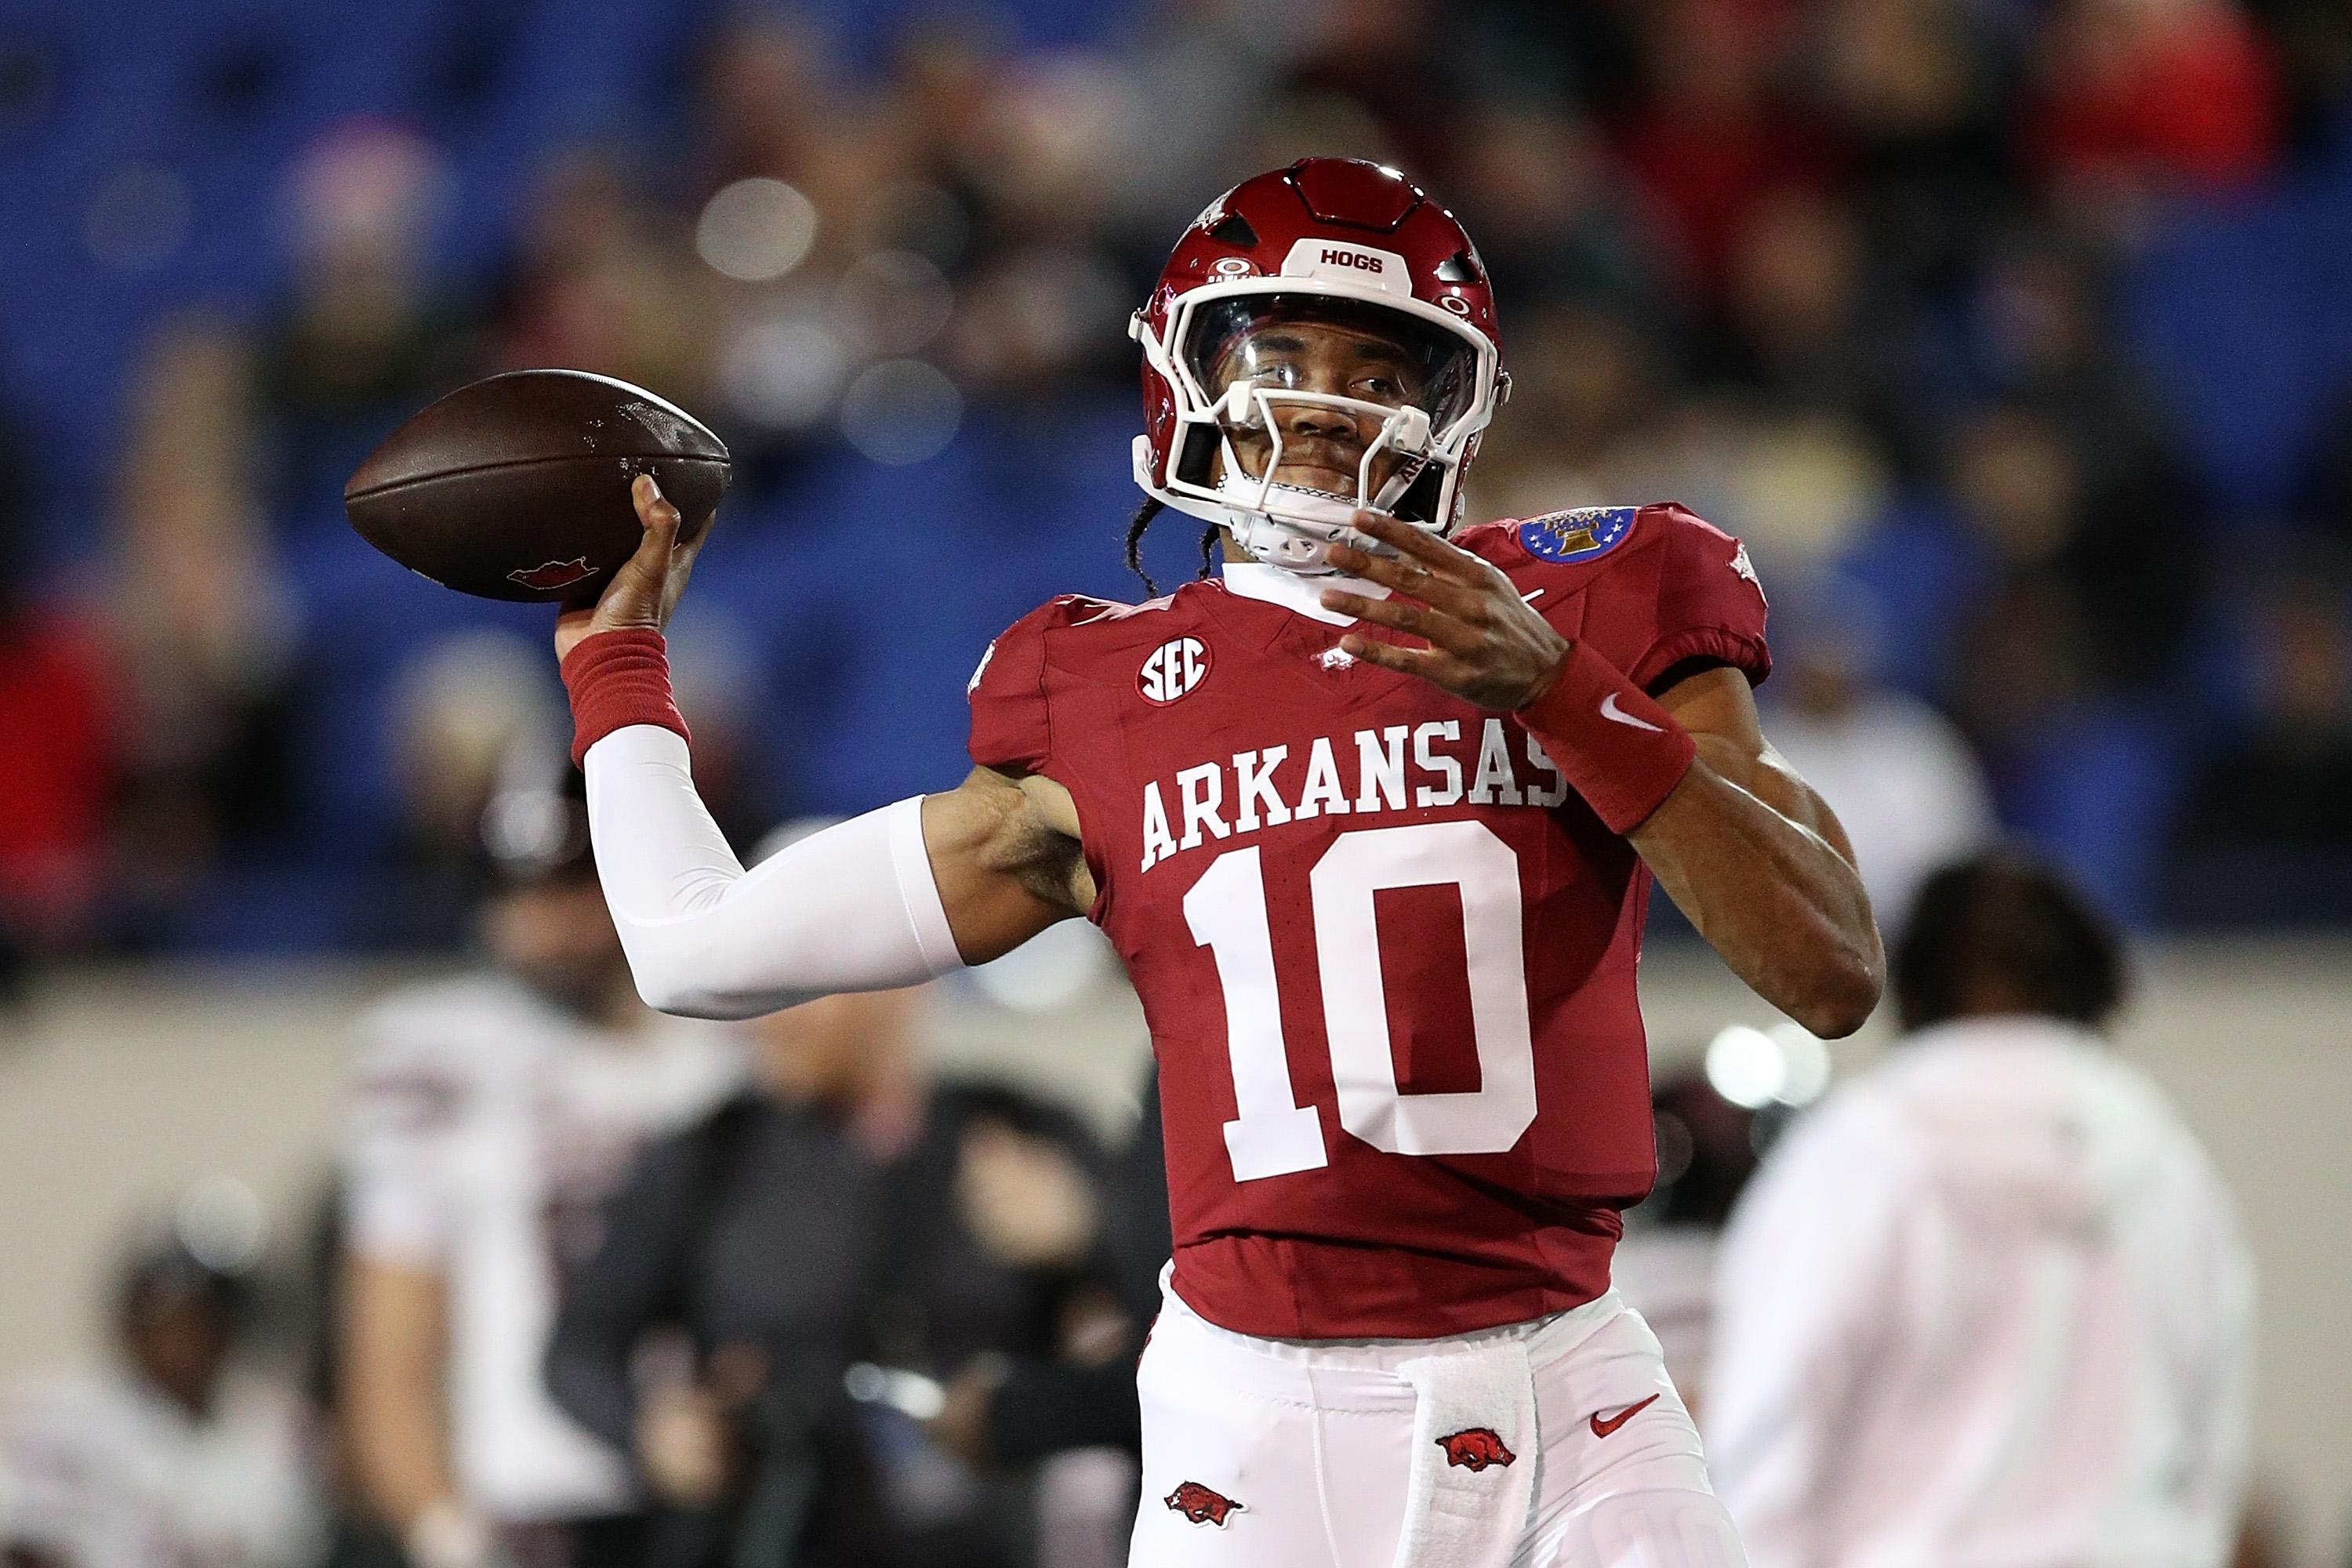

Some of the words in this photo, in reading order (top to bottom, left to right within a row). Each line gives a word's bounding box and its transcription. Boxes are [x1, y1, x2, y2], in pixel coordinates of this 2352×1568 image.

[1320, 249, 1383, 274] HOGS
[1141, 637, 1206, 702] SEC
[1142, 718, 1567, 873] ARKANSAS
[1182, 820, 1537, 1182] 10
